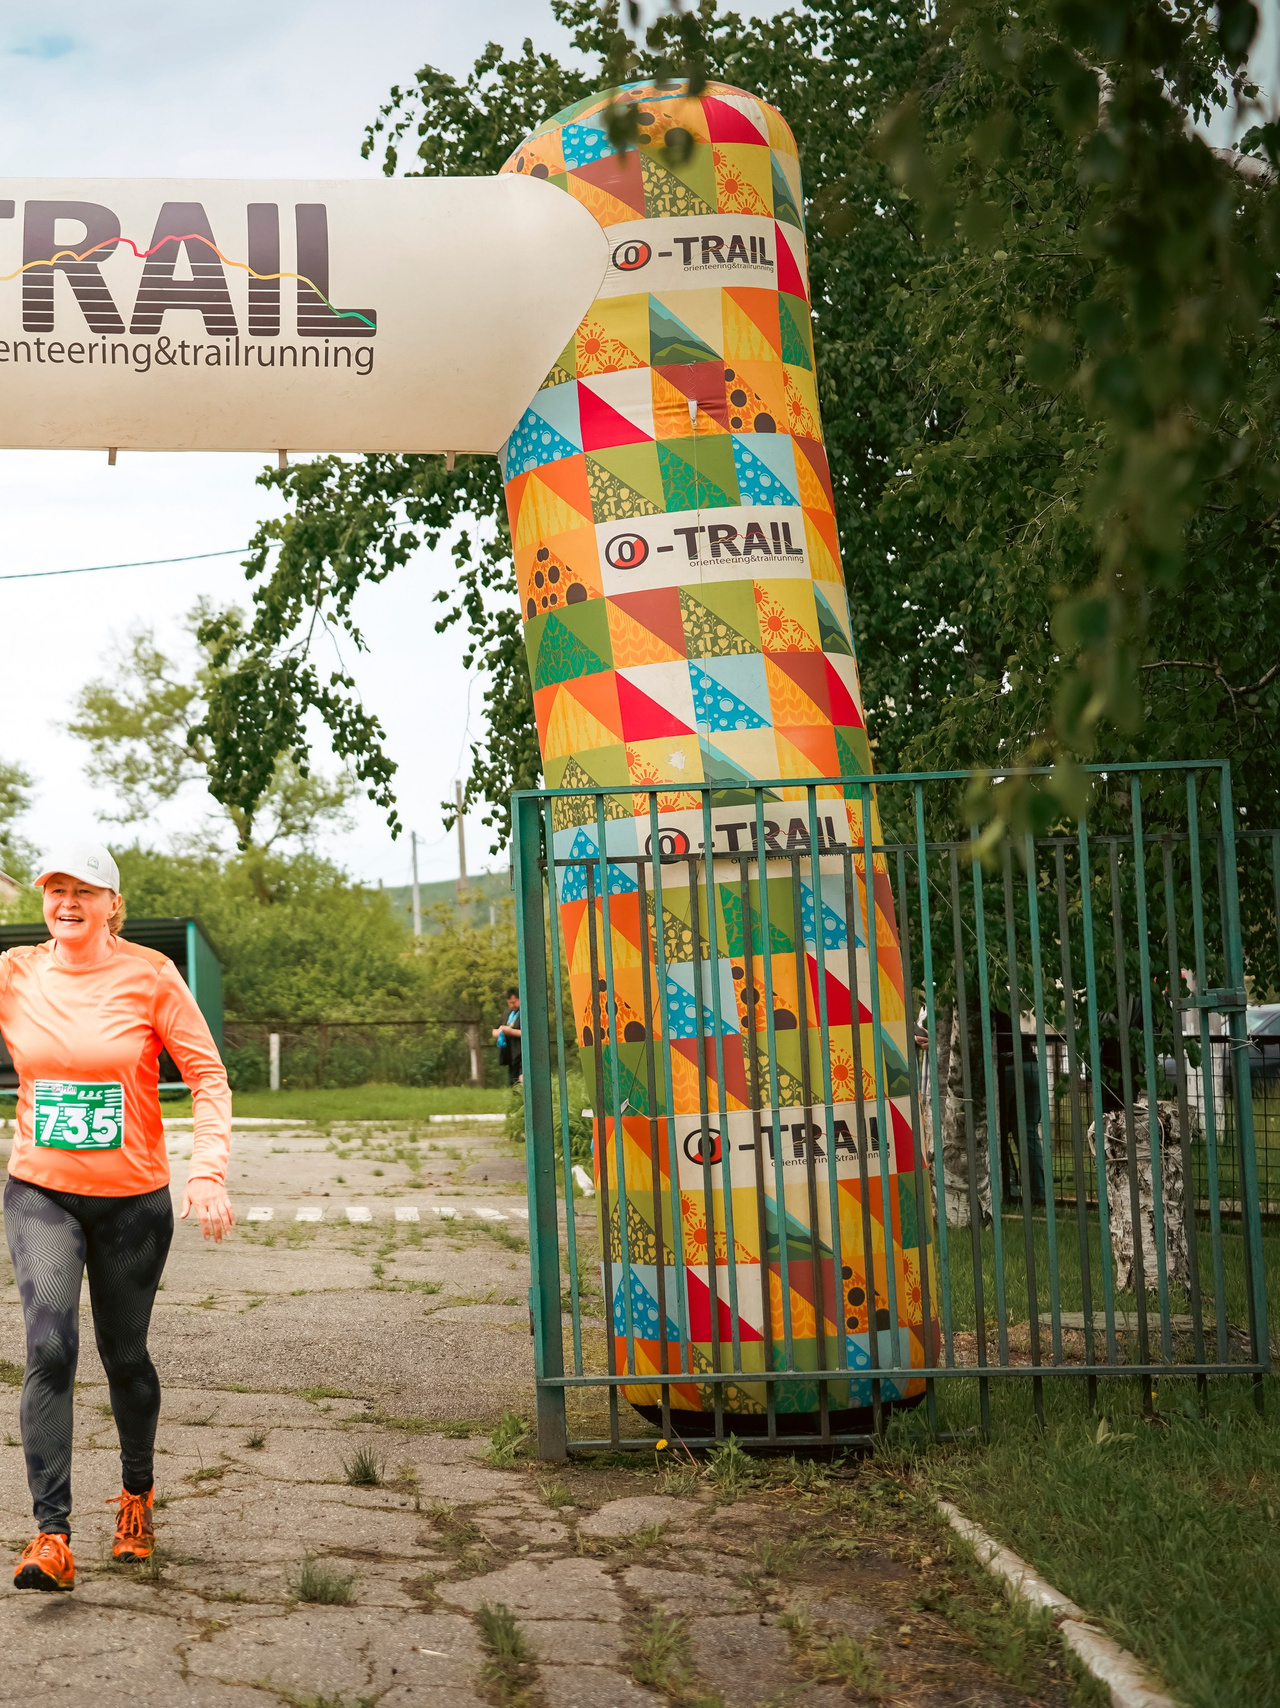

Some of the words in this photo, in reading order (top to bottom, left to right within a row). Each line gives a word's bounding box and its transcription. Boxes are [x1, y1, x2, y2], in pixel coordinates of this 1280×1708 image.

[684, 262, 774, 273] orienteering&trailrunning
[689, 554, 804, 567] orienteering&trailrunning
[39, 1105, 118, 1143] 735
